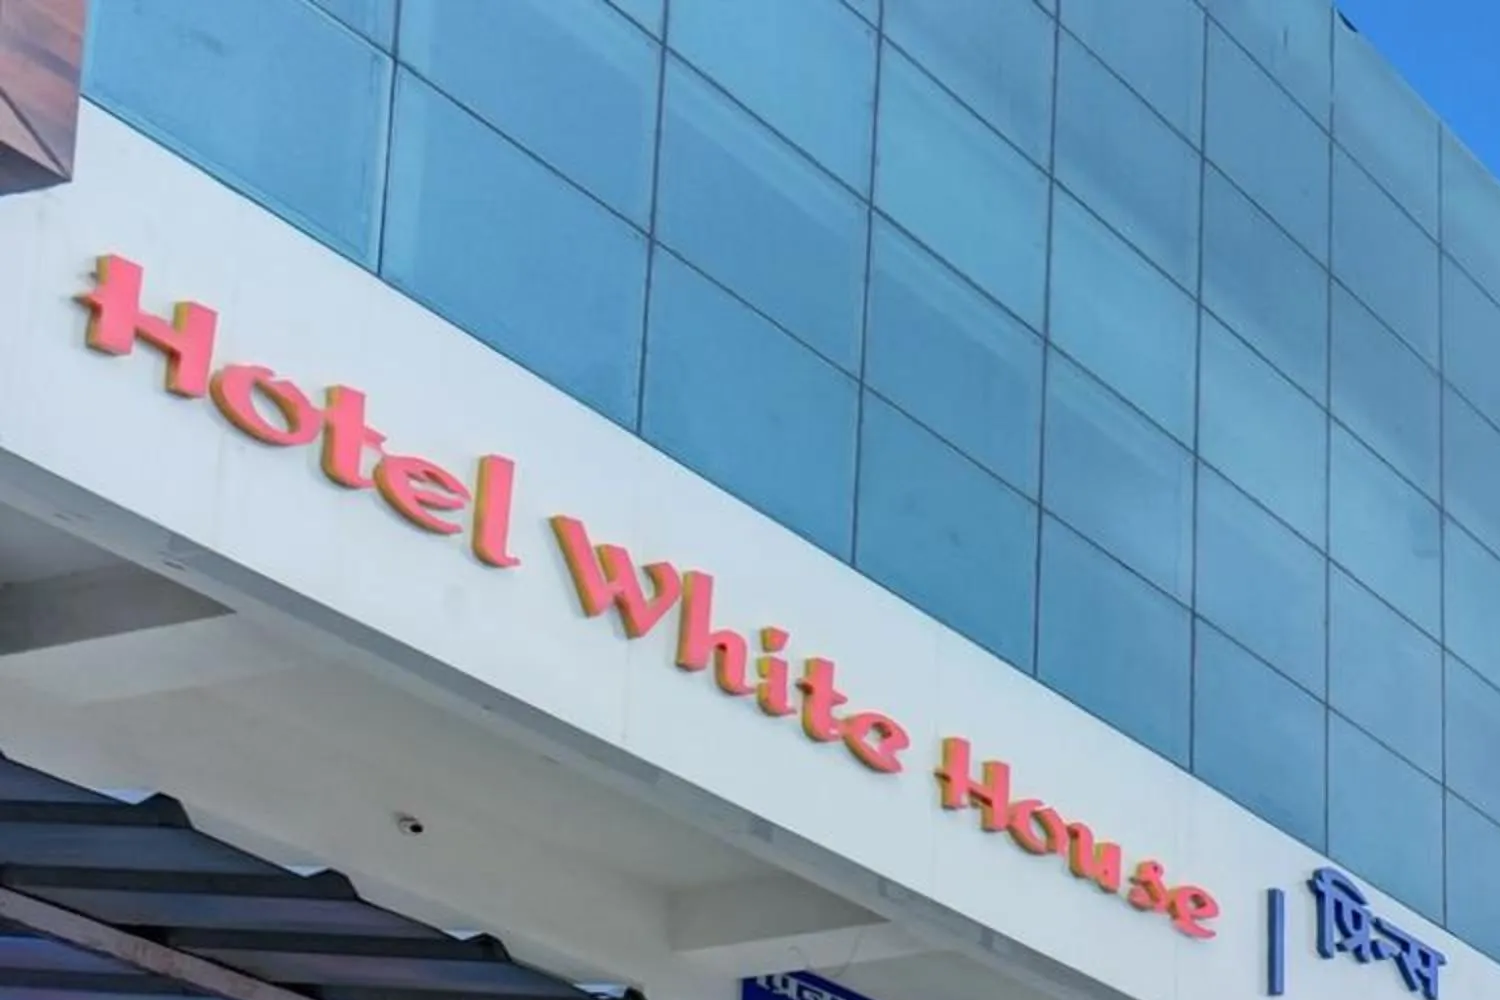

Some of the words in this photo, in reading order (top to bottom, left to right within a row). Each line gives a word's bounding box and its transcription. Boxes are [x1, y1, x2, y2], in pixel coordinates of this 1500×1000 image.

[74, 254, 520, 567] Hotel
[550, 514, 910, 774] White
[934, 736, 1220, 939] House
[1307, 867, 1447, 1000] प्रिन्स
